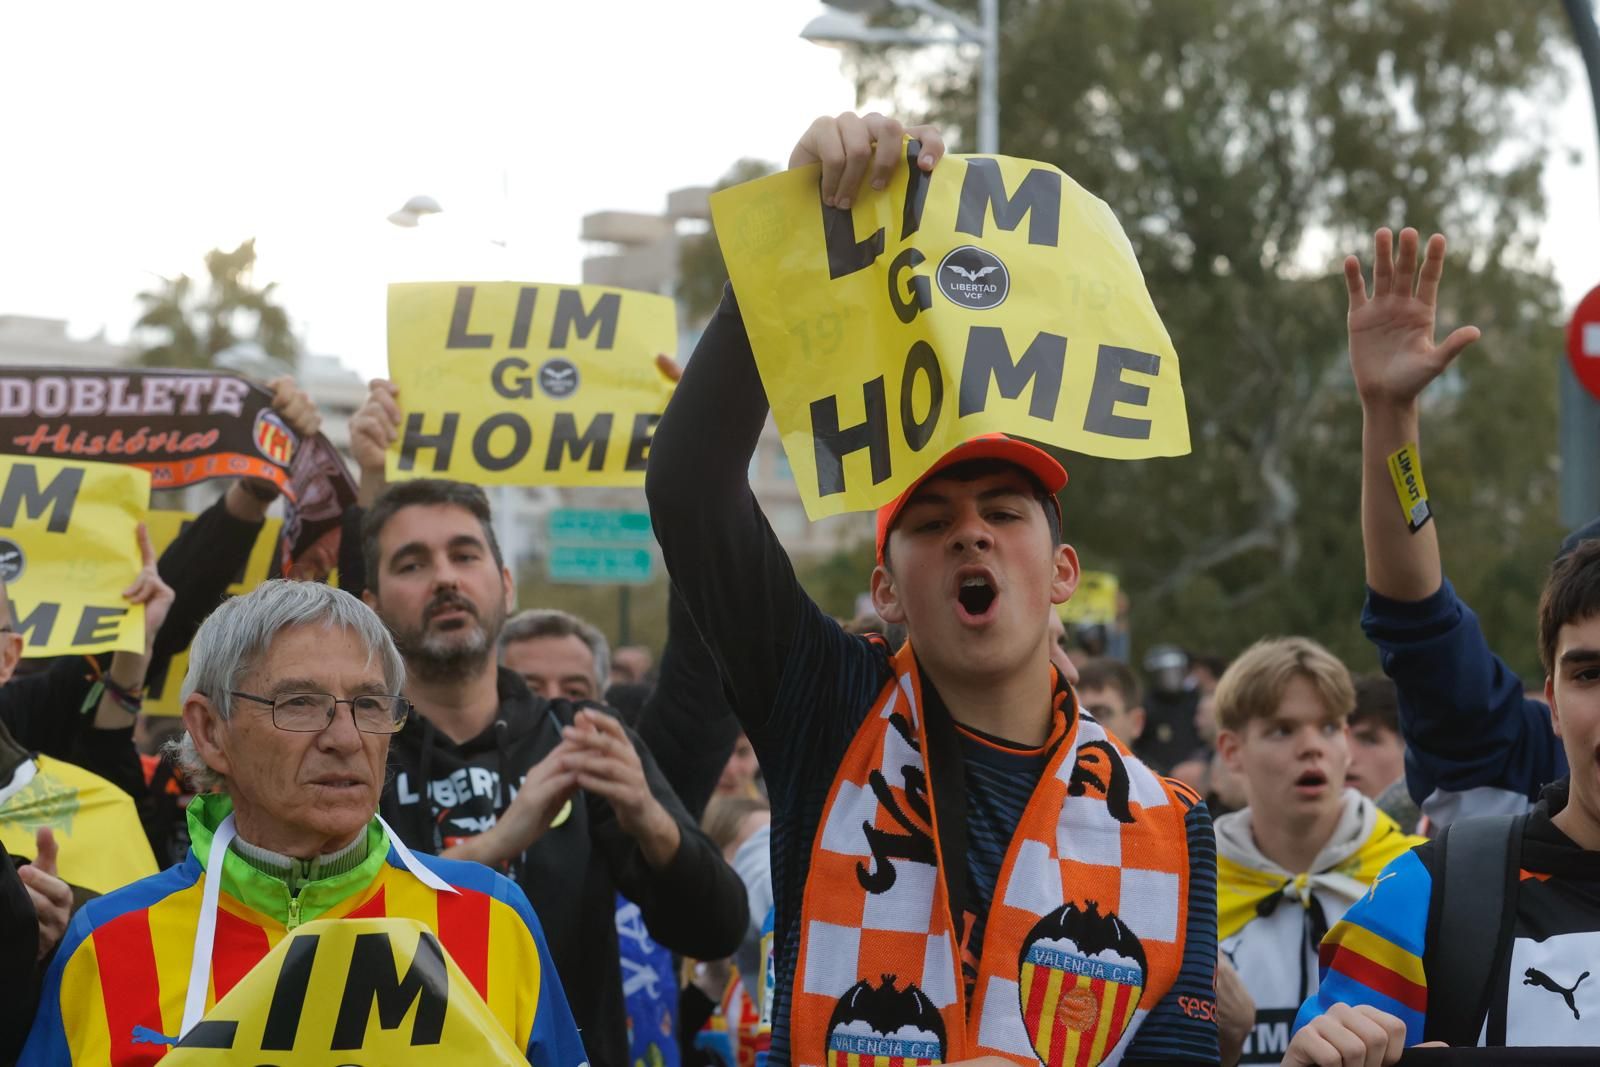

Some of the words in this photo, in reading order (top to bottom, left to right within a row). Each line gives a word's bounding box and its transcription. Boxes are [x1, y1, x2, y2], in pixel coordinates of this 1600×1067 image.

[818, 138, 1062, 280] LIM
[950, 282, 997, 293] LIBERTAD
[964, 292, 983, 300] VCF
[445, 286, 622, 350] LIM
[0, 376, 250, 418] DOBLETE
[809, 326, 1161, 498] HOME
[13, 424, 220, 455] Histórico
[397, 412, 662, 472] HOME
[1397, 448, 1413, 476] LIM
[1405, 474, 1420, 502] OUT
[1034, 948, 1105, 979] VALENCIA
[1112, 966, 1138, 985] C.F.
[836, 1036, 903, 1055] VALENCIA
[911, 1043, 937, 1057] C.F.
